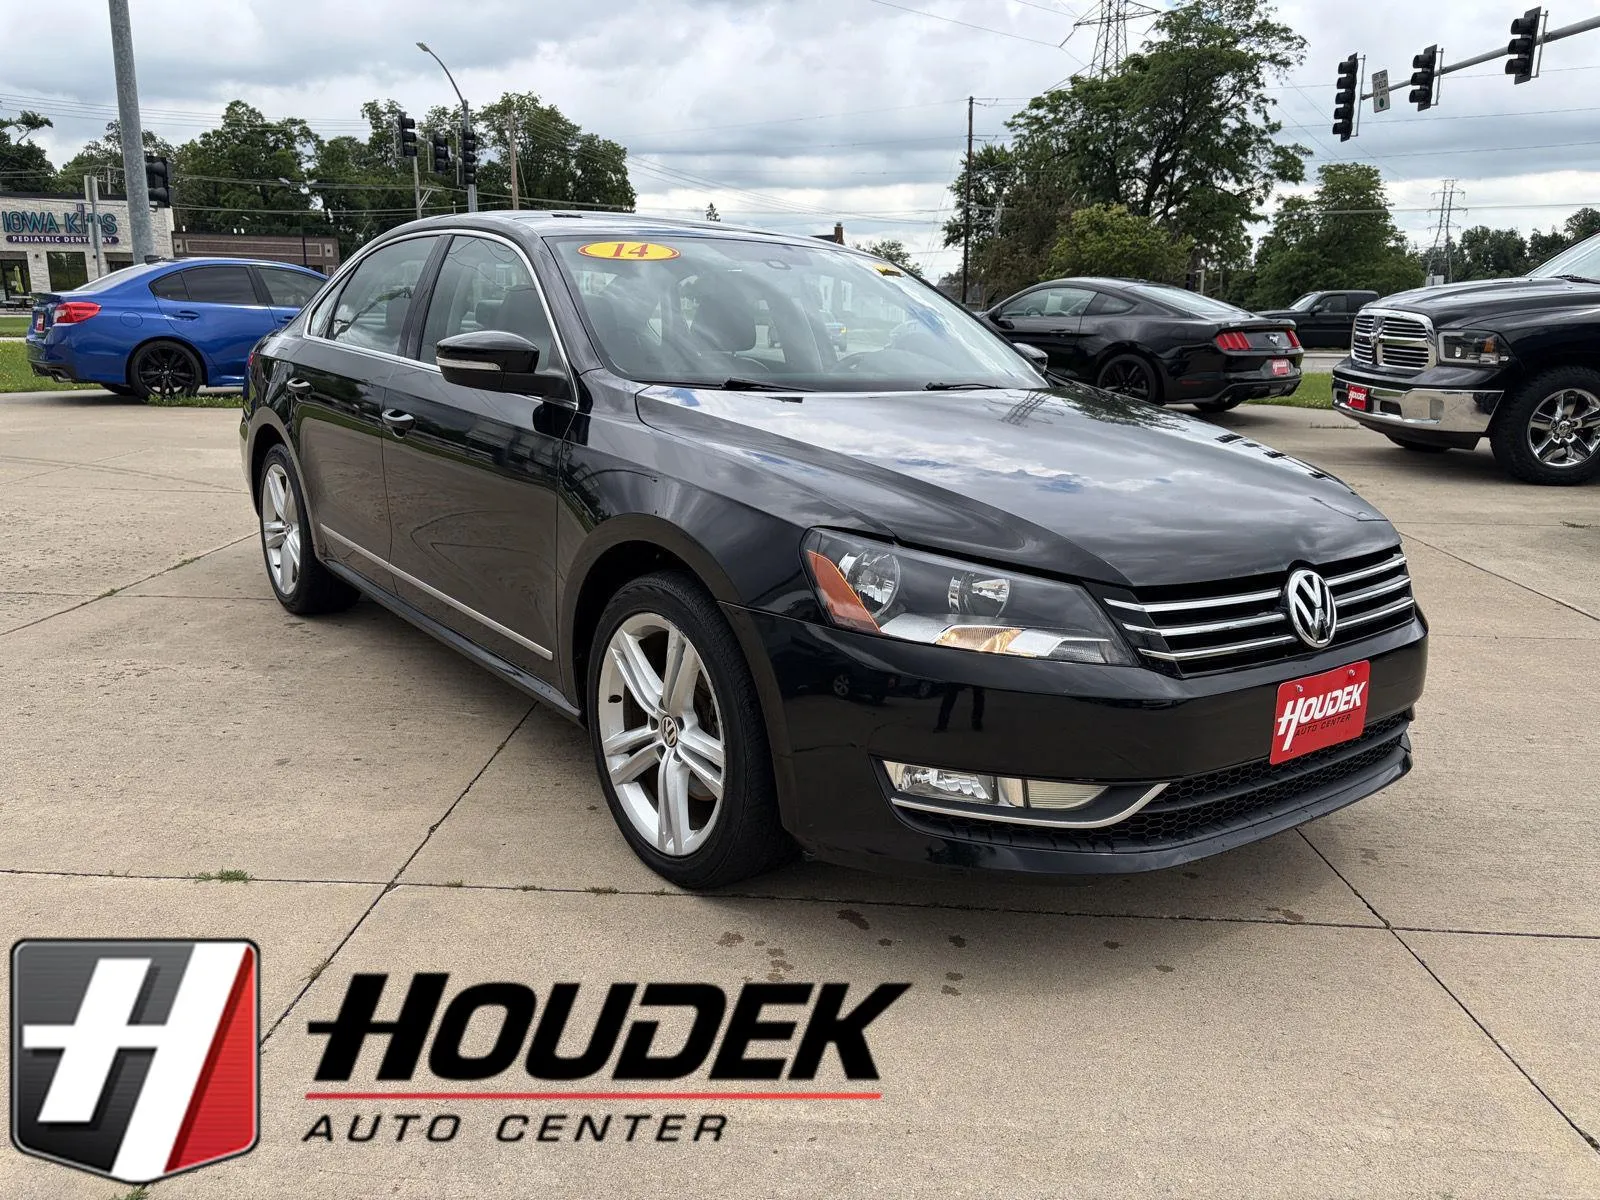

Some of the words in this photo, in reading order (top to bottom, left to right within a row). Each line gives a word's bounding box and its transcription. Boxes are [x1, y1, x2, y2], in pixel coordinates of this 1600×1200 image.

[2, 211, 60, 234] IOWA
[12, 235, 60, 243] PEDIATRIC
[64, 236, 113, 244] DENTRY
[608, 243, 649, 257] 14
[1277, 681, 1367, 751] HOUDEK
[1295, 723, 1317, 737] AUTO
[1321, 713, 1351, 728] CENTER
